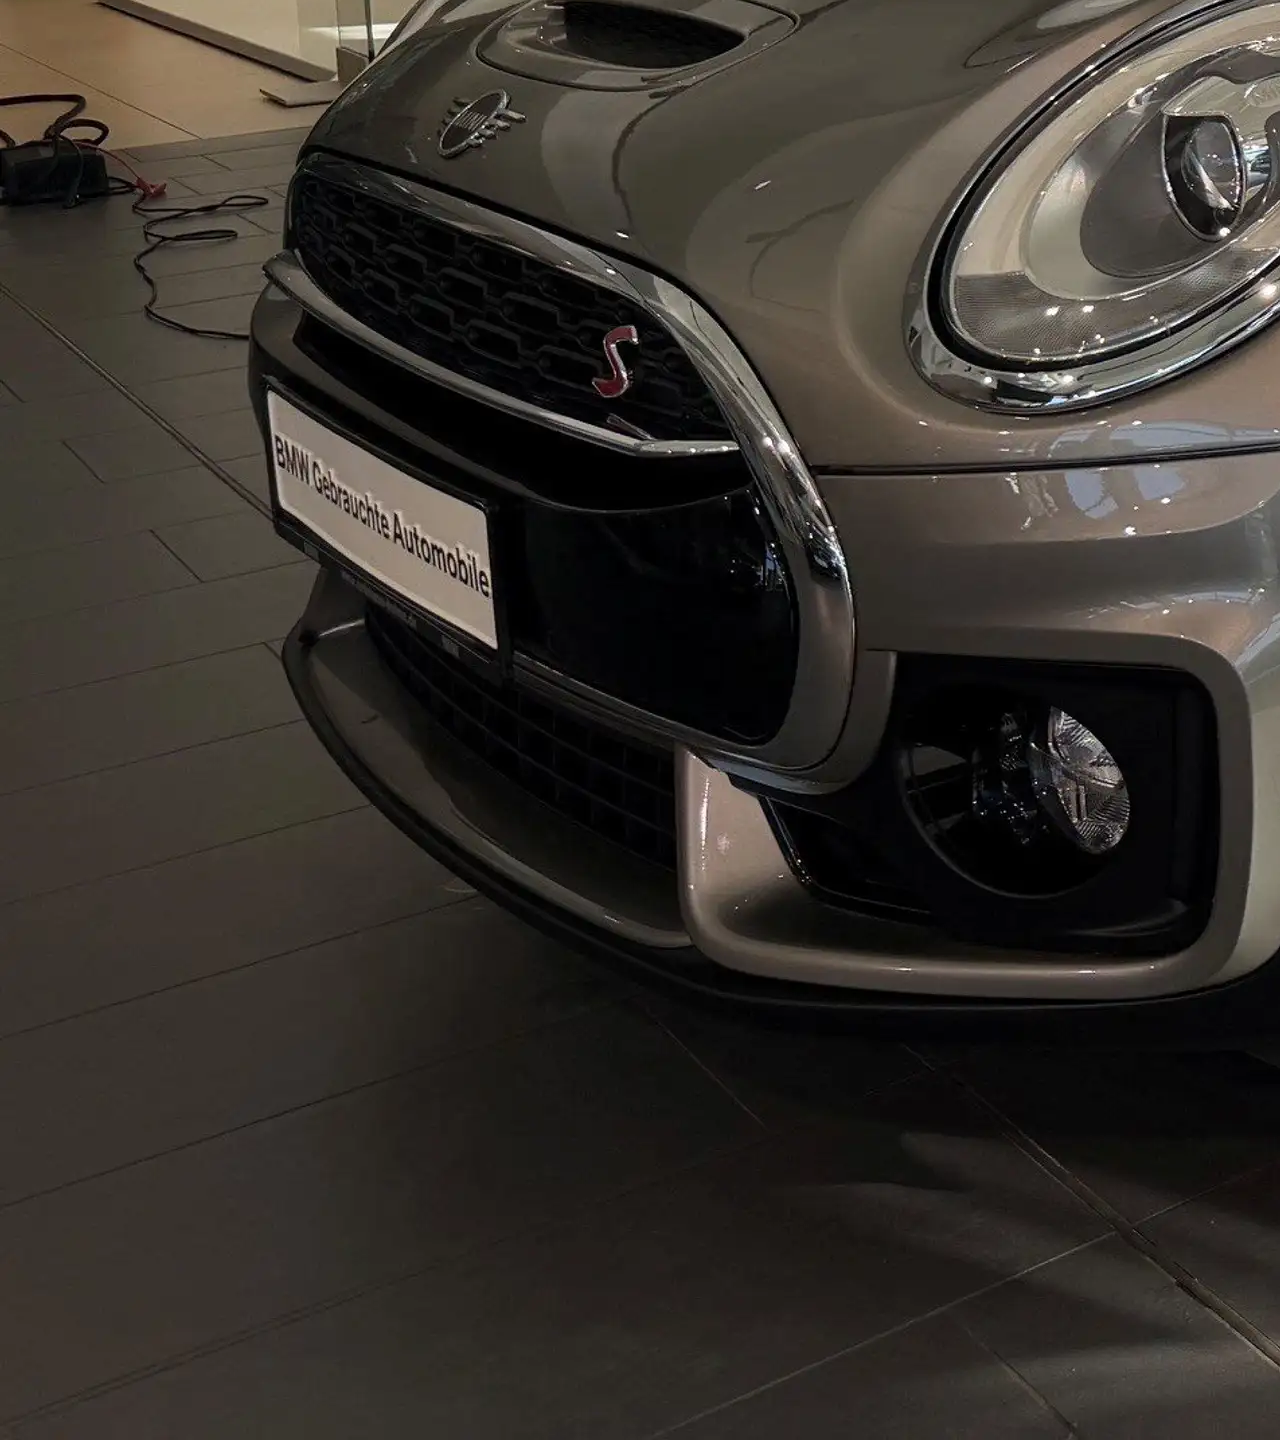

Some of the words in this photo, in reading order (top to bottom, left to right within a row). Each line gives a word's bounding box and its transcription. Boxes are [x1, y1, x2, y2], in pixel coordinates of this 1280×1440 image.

[592, 325, 639, 398] S
[274, 434, 312, 486] BMW
[313, 461, 392, 541] Gebrauchte
[393, 512, 491, 599] Automobile
